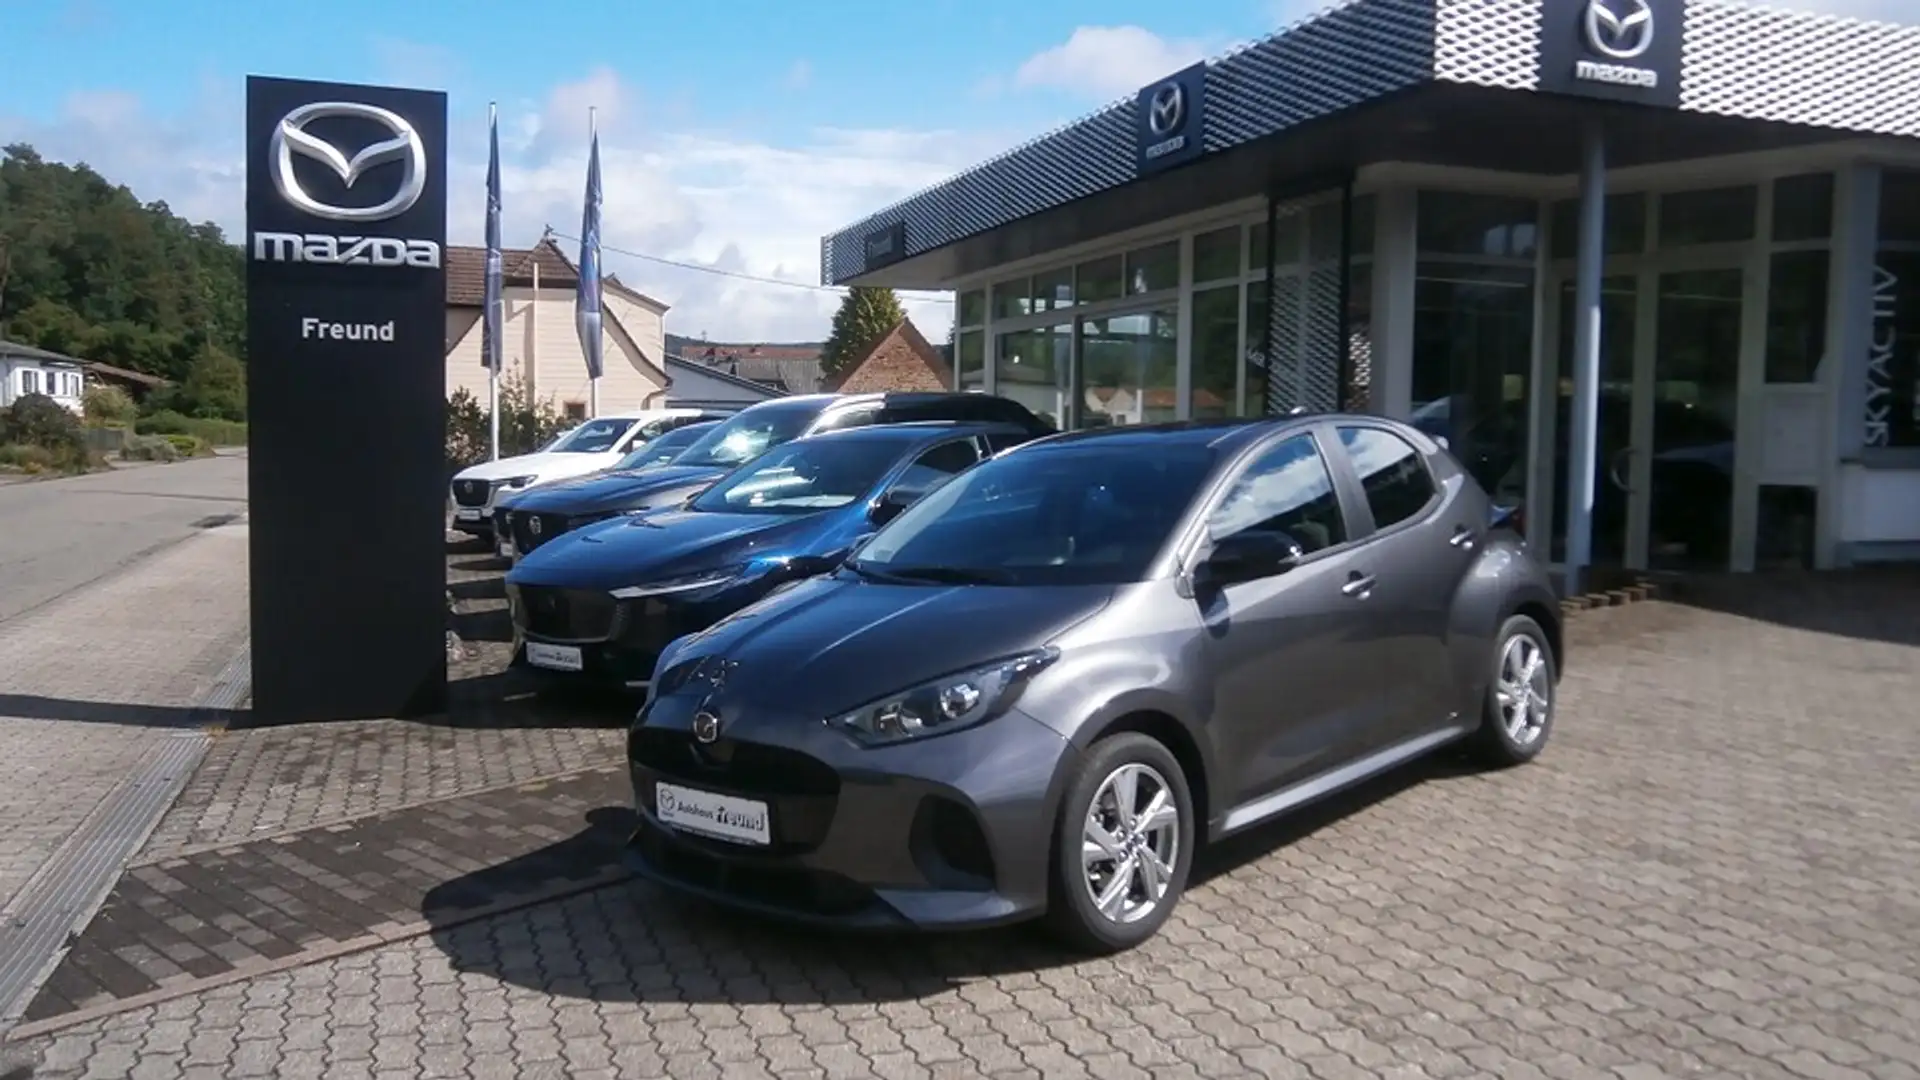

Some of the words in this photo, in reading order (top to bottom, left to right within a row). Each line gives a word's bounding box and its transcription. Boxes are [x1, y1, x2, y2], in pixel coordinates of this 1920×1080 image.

[1576, 60, 1658, 88] mazda
[254, 231, 440, 269] mazda
[302, 317, 395, 342] Freund
[1864, 264, 1898, 447] SKYACTIV
